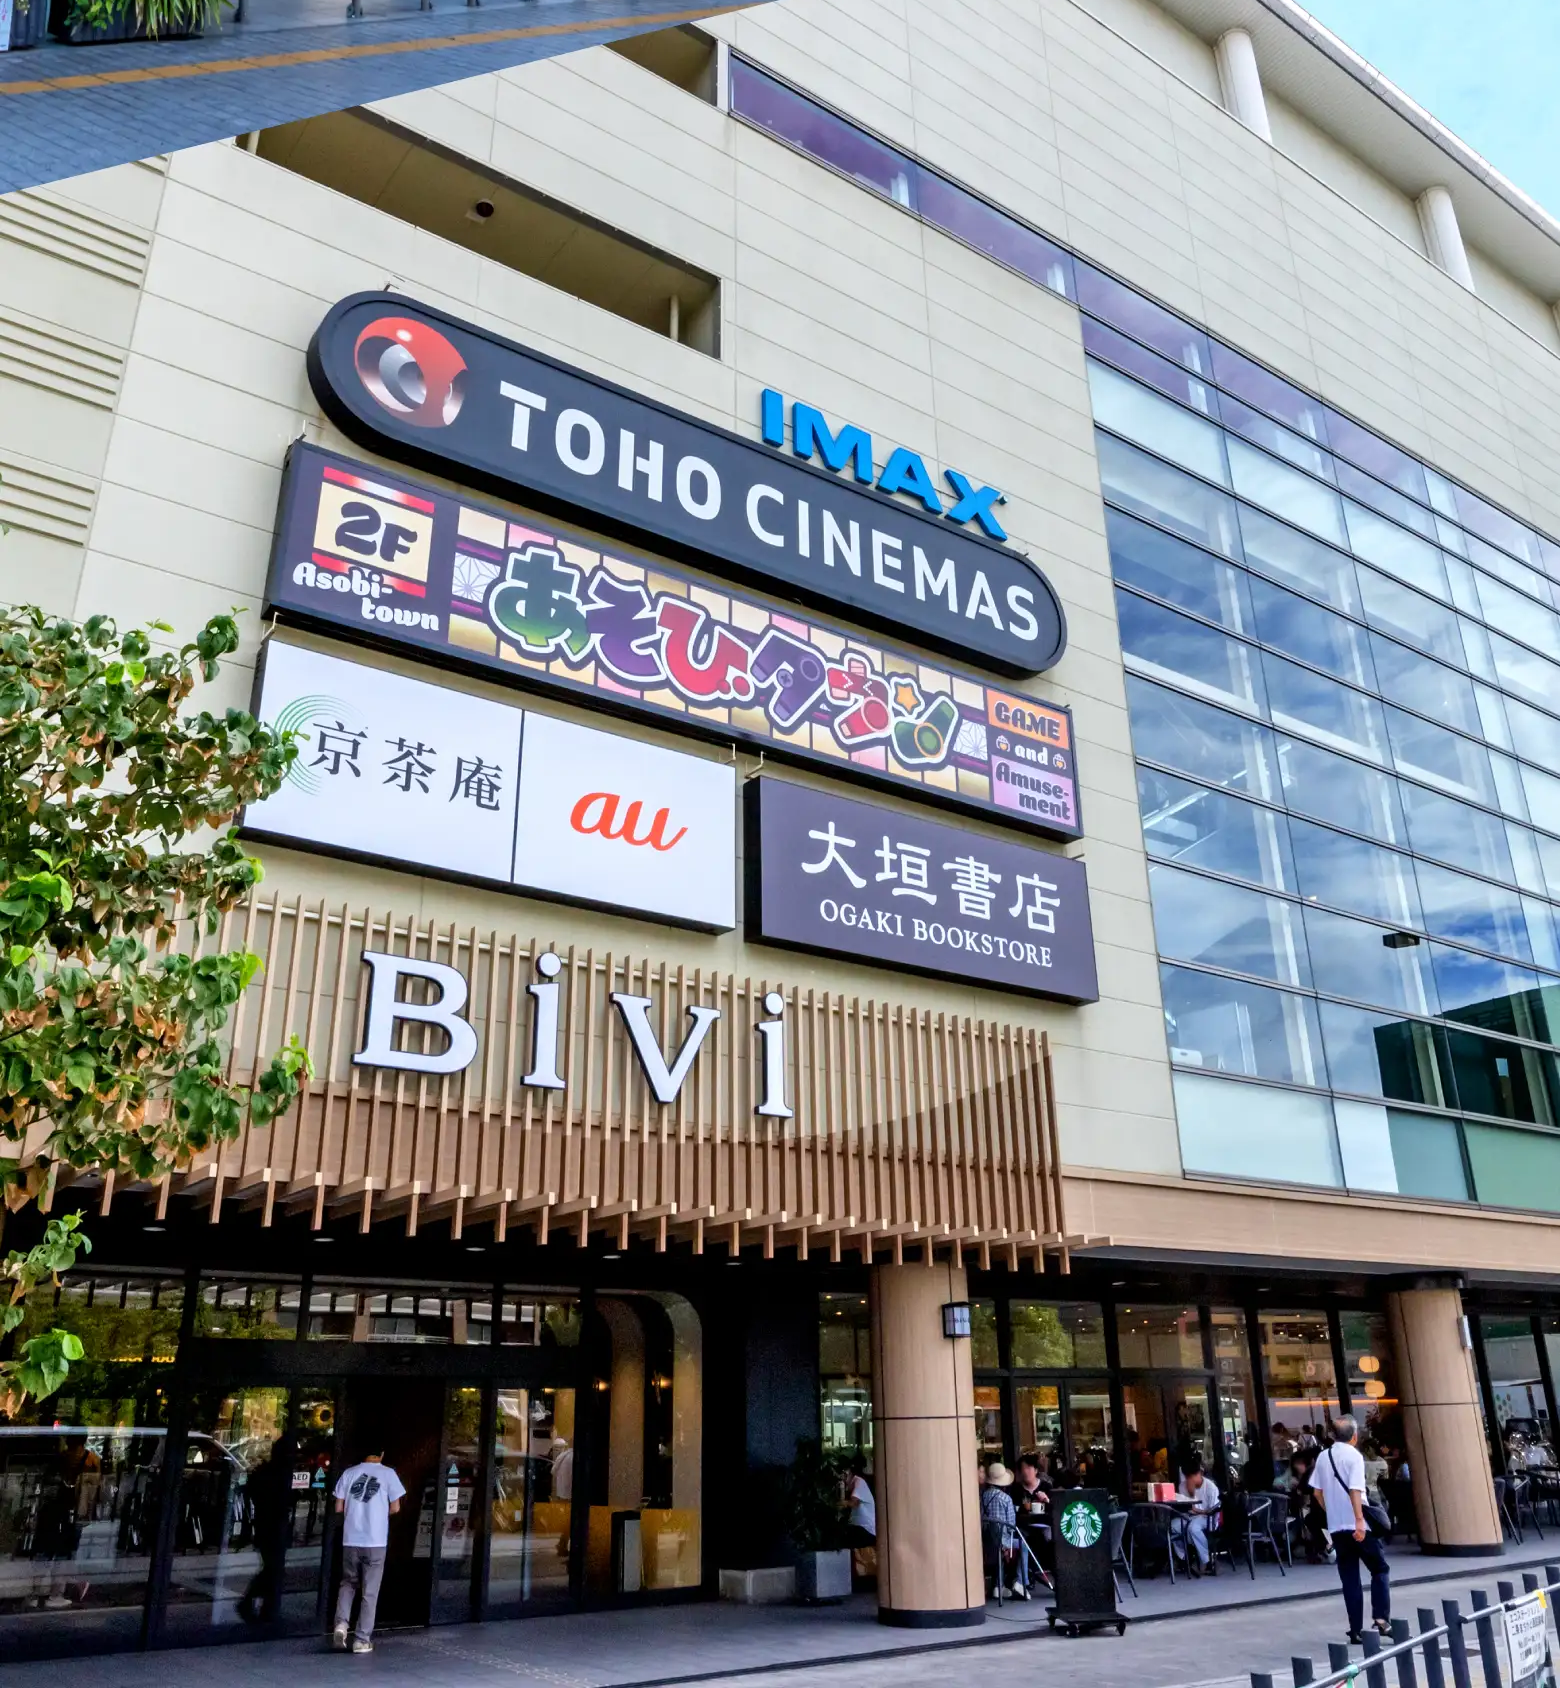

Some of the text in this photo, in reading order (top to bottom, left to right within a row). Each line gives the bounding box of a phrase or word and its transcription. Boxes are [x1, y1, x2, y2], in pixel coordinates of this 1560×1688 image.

[761, 388, 1008, 542] IMAX
[334, 501, 418, 563] 2F
[499, 380, 1040, 642] TOHO CINEMAS
[292, 561, 393, 600] Asobi-
[360, 596, 440, 632] town
[488, 545, 960, 766] あそびタウン
[994, 700, 1061, 741] GAME
[308, 720, 504, 812] 京茶庵
[995, 761, 1070, 800] Amuse-
[1014, 743, 1049, 766] and
[569, 791, 689, 852] au
[1018, 792, 1071, 820] ment
[801, 821, 1061, 934] 大垣書店
[819, 899, 1053, 968] OGAKI BOOKSTORE
